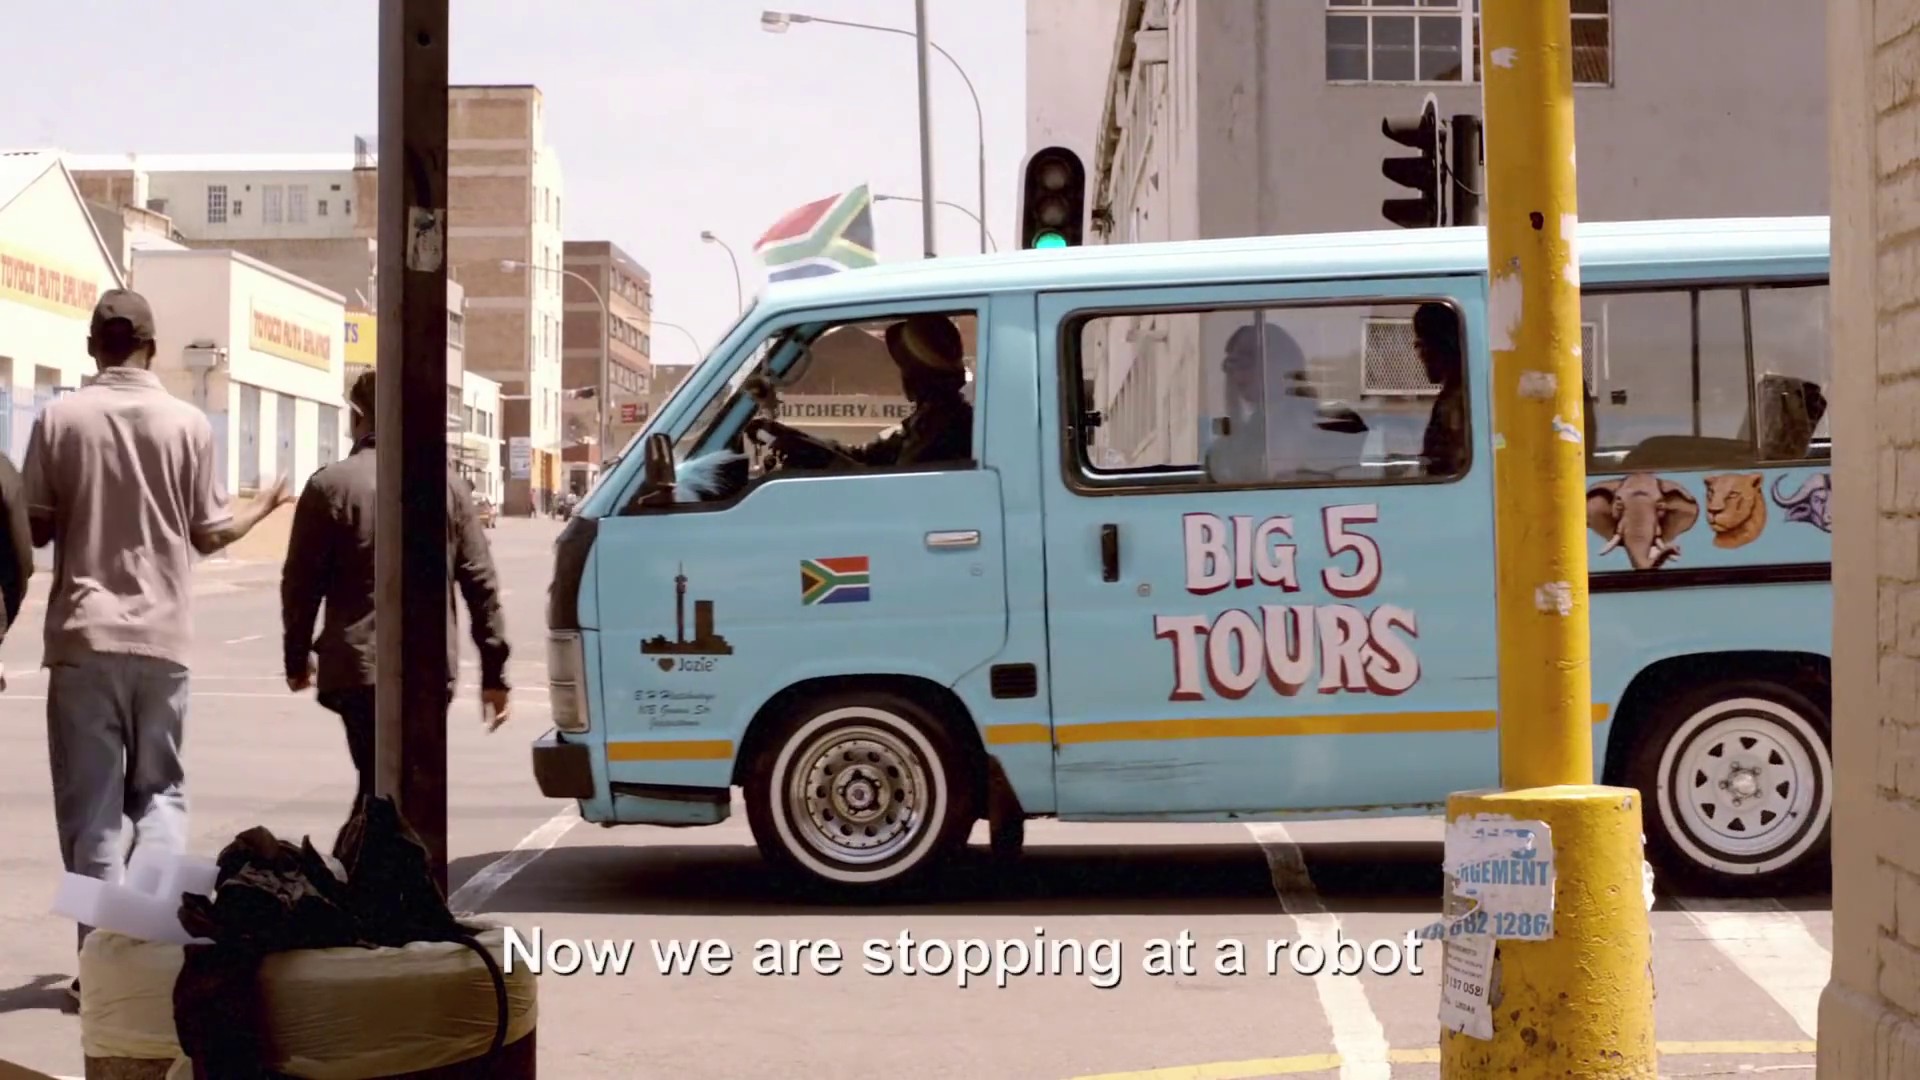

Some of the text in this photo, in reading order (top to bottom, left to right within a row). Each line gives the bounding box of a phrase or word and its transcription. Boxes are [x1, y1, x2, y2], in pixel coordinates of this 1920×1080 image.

[777, 403, 867, 417] UTCHERY
[1182, 503, 1382, 599] BIG 5
[1152, 604, 1421, 701] TOURS
